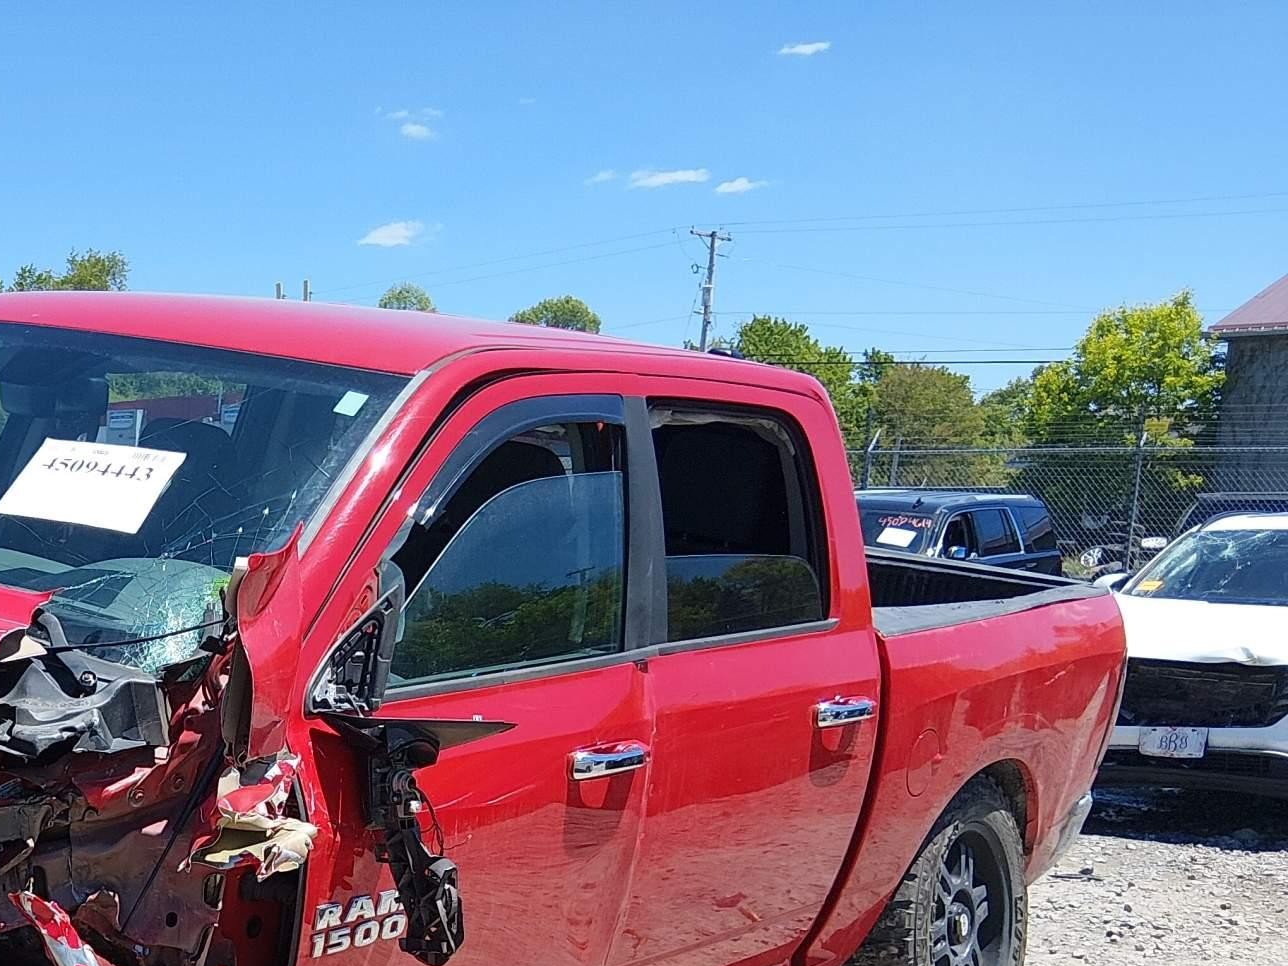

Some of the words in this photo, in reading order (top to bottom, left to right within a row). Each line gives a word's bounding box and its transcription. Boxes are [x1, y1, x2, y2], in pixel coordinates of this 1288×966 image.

[43, 456, 154, 481] 45094443
[315, 889, 405, 930] RAM
[312, 913, 408, 959] 1500
